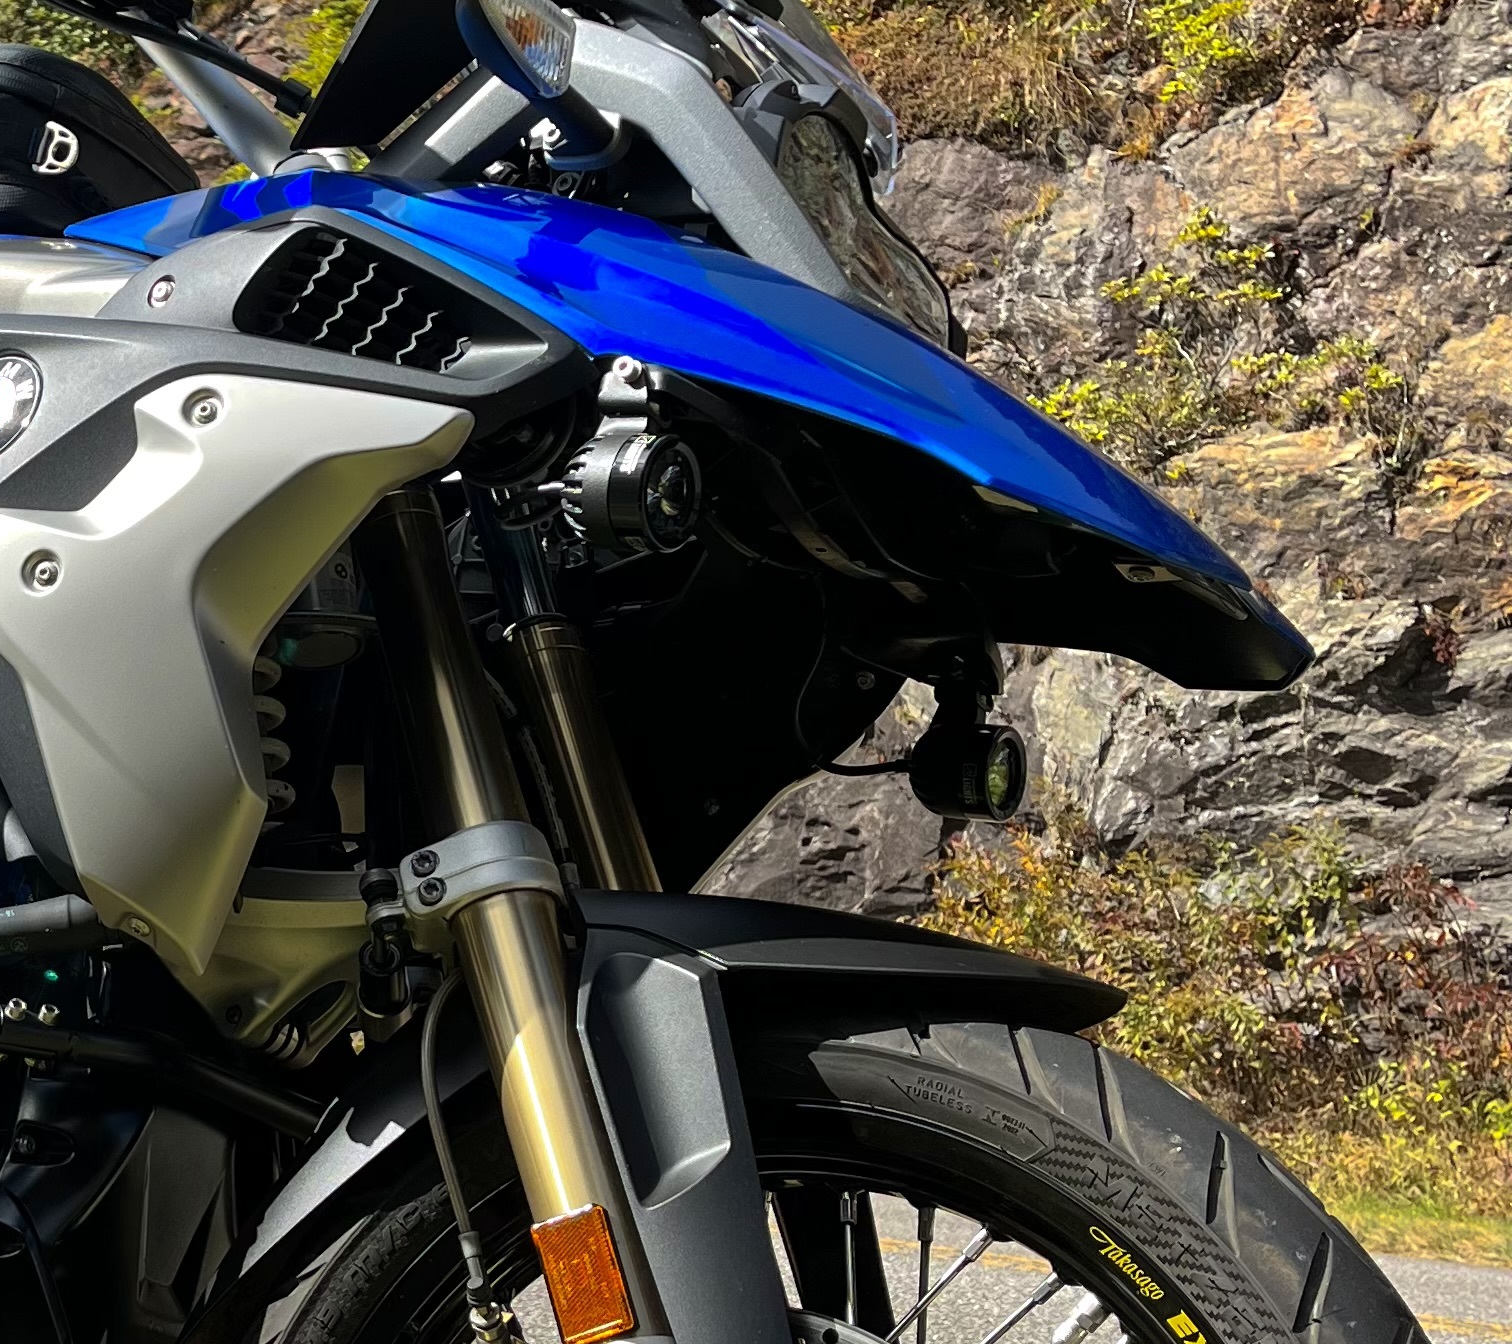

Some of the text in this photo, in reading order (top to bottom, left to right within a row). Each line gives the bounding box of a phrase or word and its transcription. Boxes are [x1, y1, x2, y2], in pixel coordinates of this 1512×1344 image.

[904, 1085, 973, 1115] TUBELESS
[916, 1076, 965, 1099] RADIAL
[1089, 1226, 1165, 1301] Takasago
